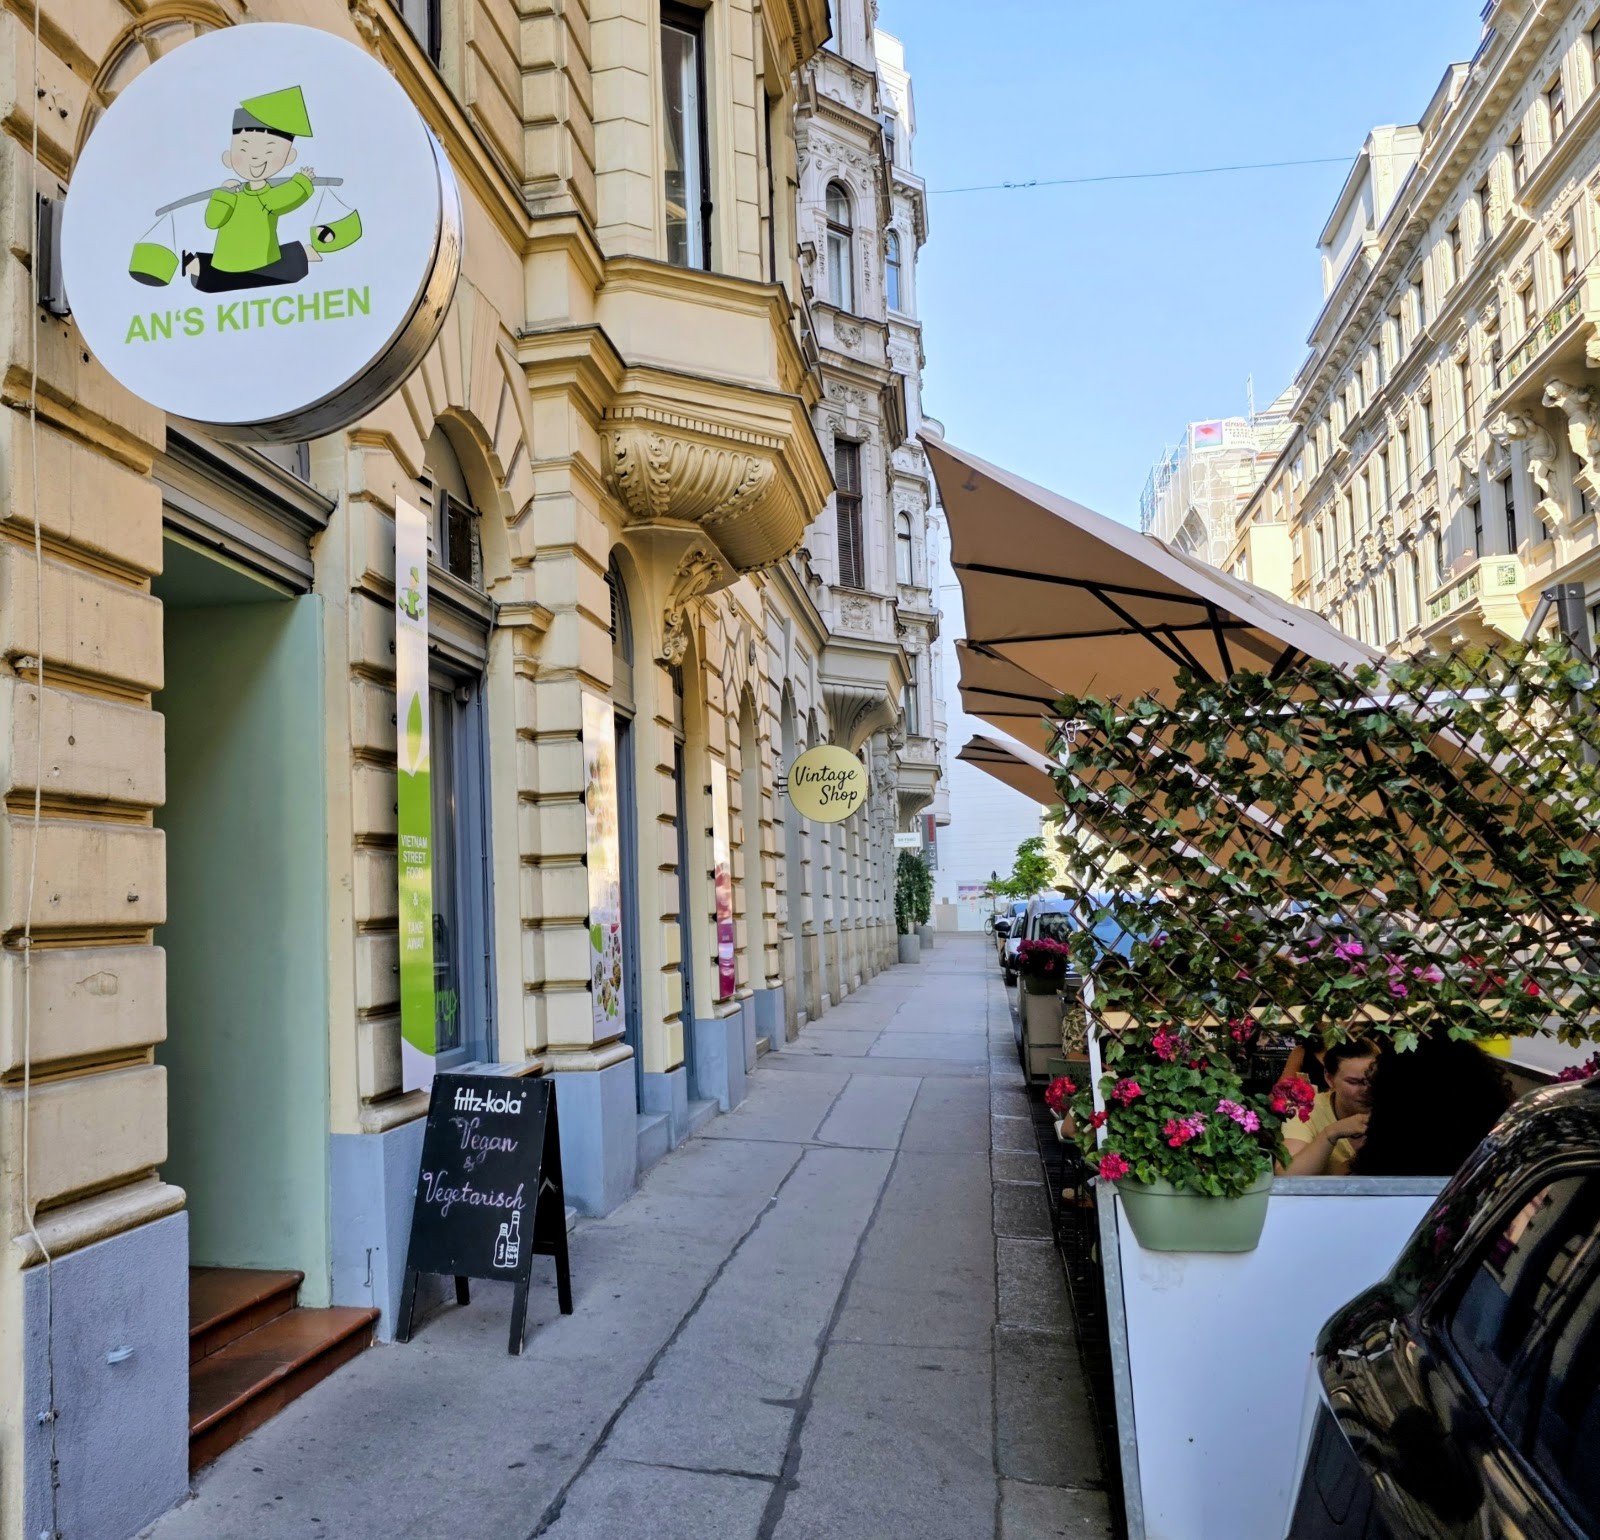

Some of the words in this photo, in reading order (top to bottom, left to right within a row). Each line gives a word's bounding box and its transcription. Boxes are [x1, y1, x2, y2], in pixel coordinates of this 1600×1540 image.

[124, 307, 205, 344] AN'S
[217, 286, 371, 333] KITCHEN
[795, 765, 858, 790] Vintage
[819, 785, 858, 809] Shop
[400, 834, 428, 849] VIETNAM
[402, 850, 426, 864] STREET
[406, 866, 424, 880] FOOD
[450, 1116, 518, 1162] Vegan
[422, 1171, 527, 1218] Vegetarisch
